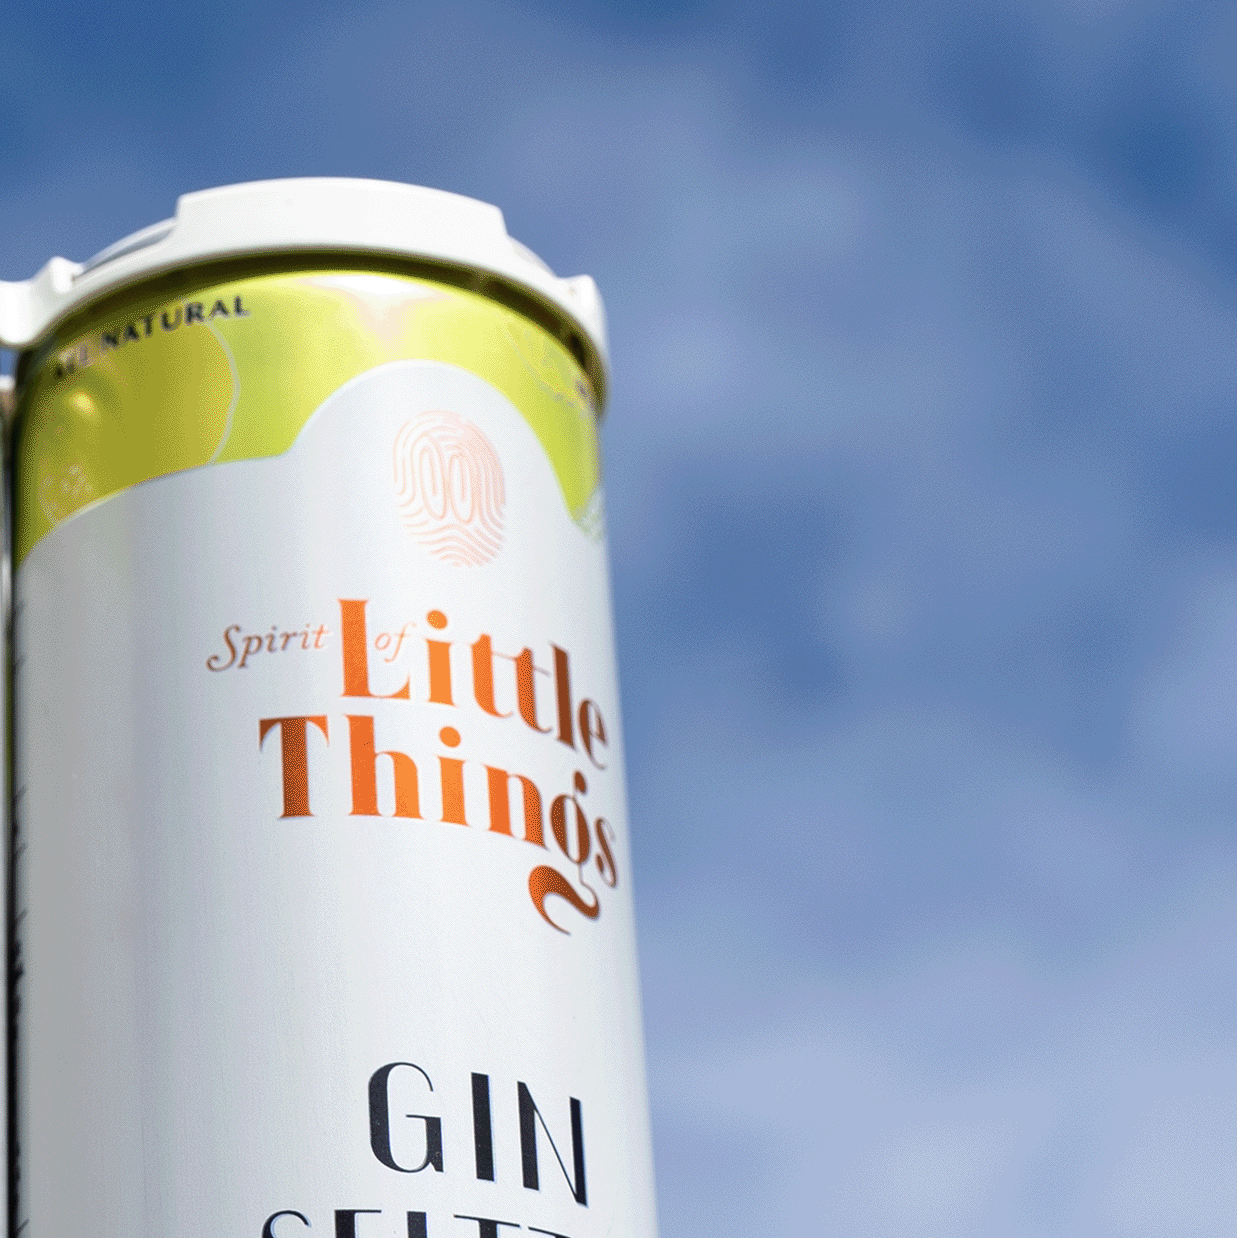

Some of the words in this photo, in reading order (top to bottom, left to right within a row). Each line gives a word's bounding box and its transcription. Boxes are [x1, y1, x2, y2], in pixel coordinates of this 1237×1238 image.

[100, 295, 251, 354] NATURAL
[205, 622, 331, 673] Spirit
[337, 597, 609, 770] Little
[373, 621, 417, 663] of
[258, 713, 618, 936] Things
[367, 1061, 589, 1208] GIN
